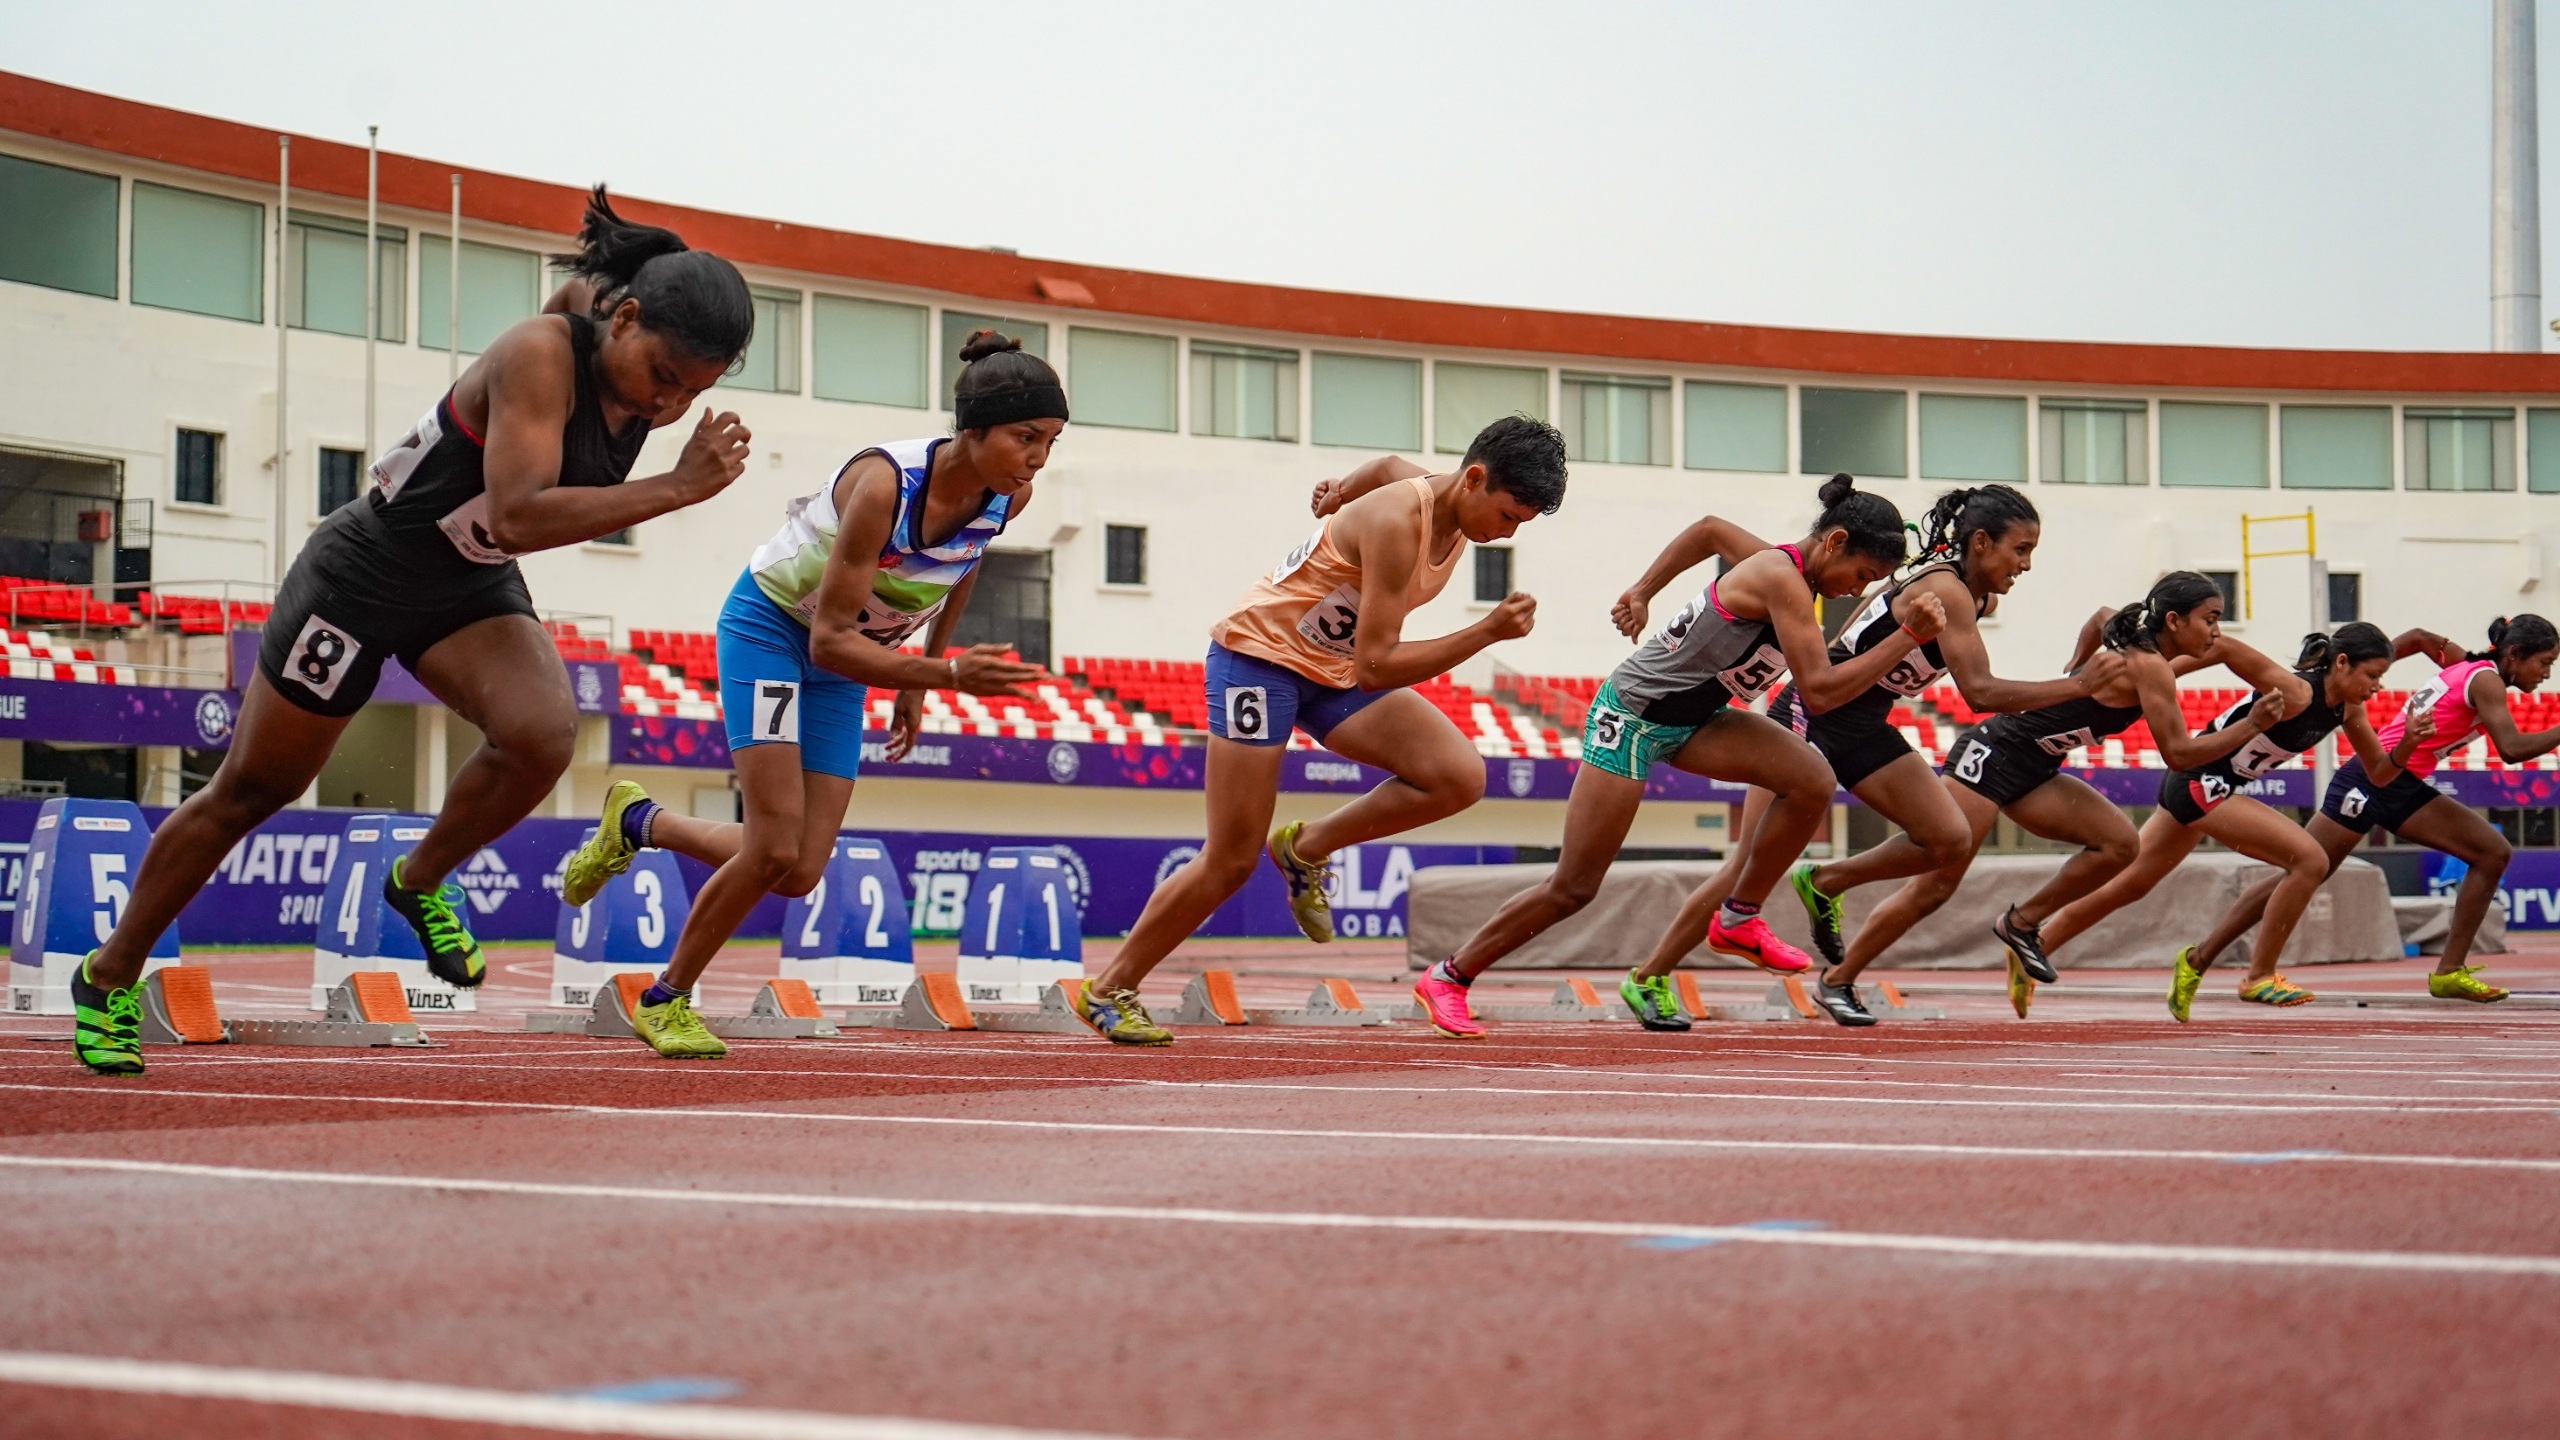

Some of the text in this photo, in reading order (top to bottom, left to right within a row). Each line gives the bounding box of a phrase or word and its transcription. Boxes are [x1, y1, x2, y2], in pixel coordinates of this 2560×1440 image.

[1318, 605, 1358, 648] 3
[297, 630, 347, 682] 8
[762, 687, 794, 735] 7
[1233, 691, 1262, 735] 6
[1598, 712, 1620, 743] 5
[1963, 747, 1985, 778] 3
[2266, 778, 2287, 796] FC
[457, 873, 520, 889] NIVIA
[915, 848, 981, 871] sports
[22, 851, 46, 945] 5
[90, 853, 131, 944] 5
[336, 861, 367, 947] 4
[634, 869, 666, 949] 3
[799, 875, 827, 948] 2
[859, 874, 889, 948] 2
[908, 872, 970, 930] 18
[987, 882, 1006, 952] 1
[1042, 882, 1061, 952] 1
[1333, 913, 1405, 938] OBA
[407, 987, 456, 1010] Vinex
[857, 984, 899, 1002] Vinex
